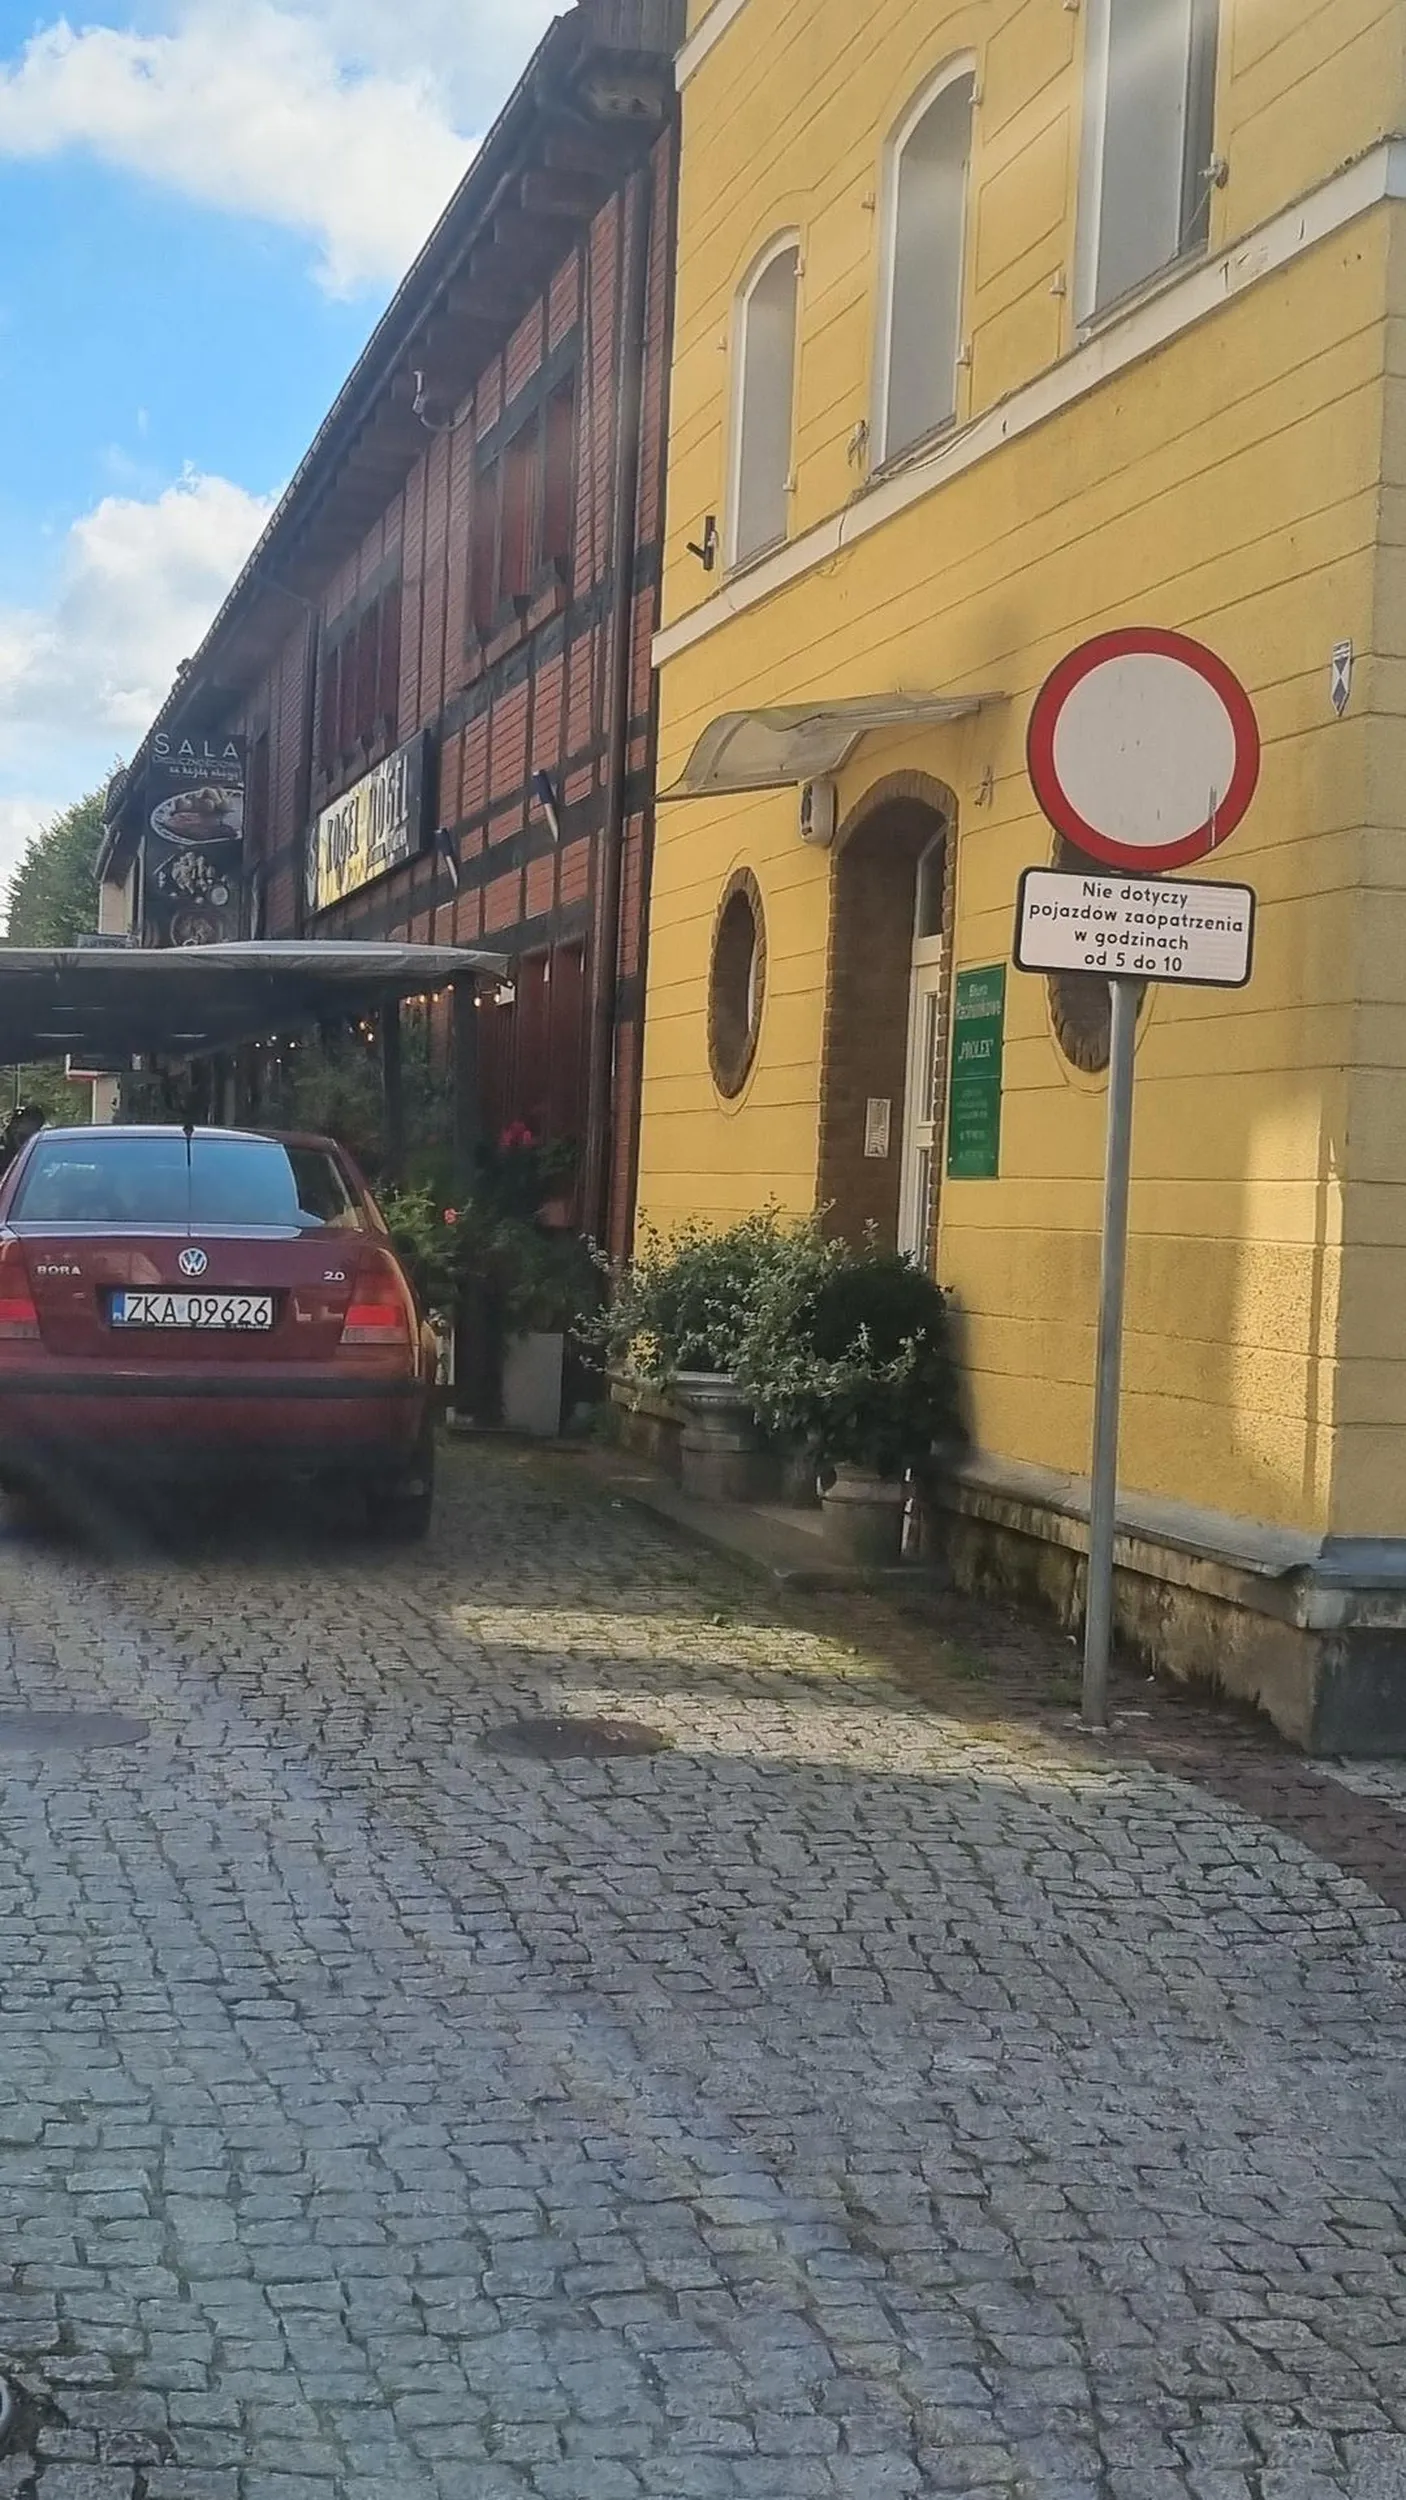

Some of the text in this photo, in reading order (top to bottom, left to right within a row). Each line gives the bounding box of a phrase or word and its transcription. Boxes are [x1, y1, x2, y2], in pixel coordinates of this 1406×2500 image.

[154, 732, 239, 759] SALA
[1082, 881, 1189, 908] Nie dotyczy
[1029, 901, 1244, 932] pojazdów zaopatrzenia
[1074, 929, 1189, 951] w godzinach
[1084, 952, 1183, 972] od 5 do 10
[37, 1265, 82, 1276] BORA
[127, 1296, 270, 1325] ZKA 09626
